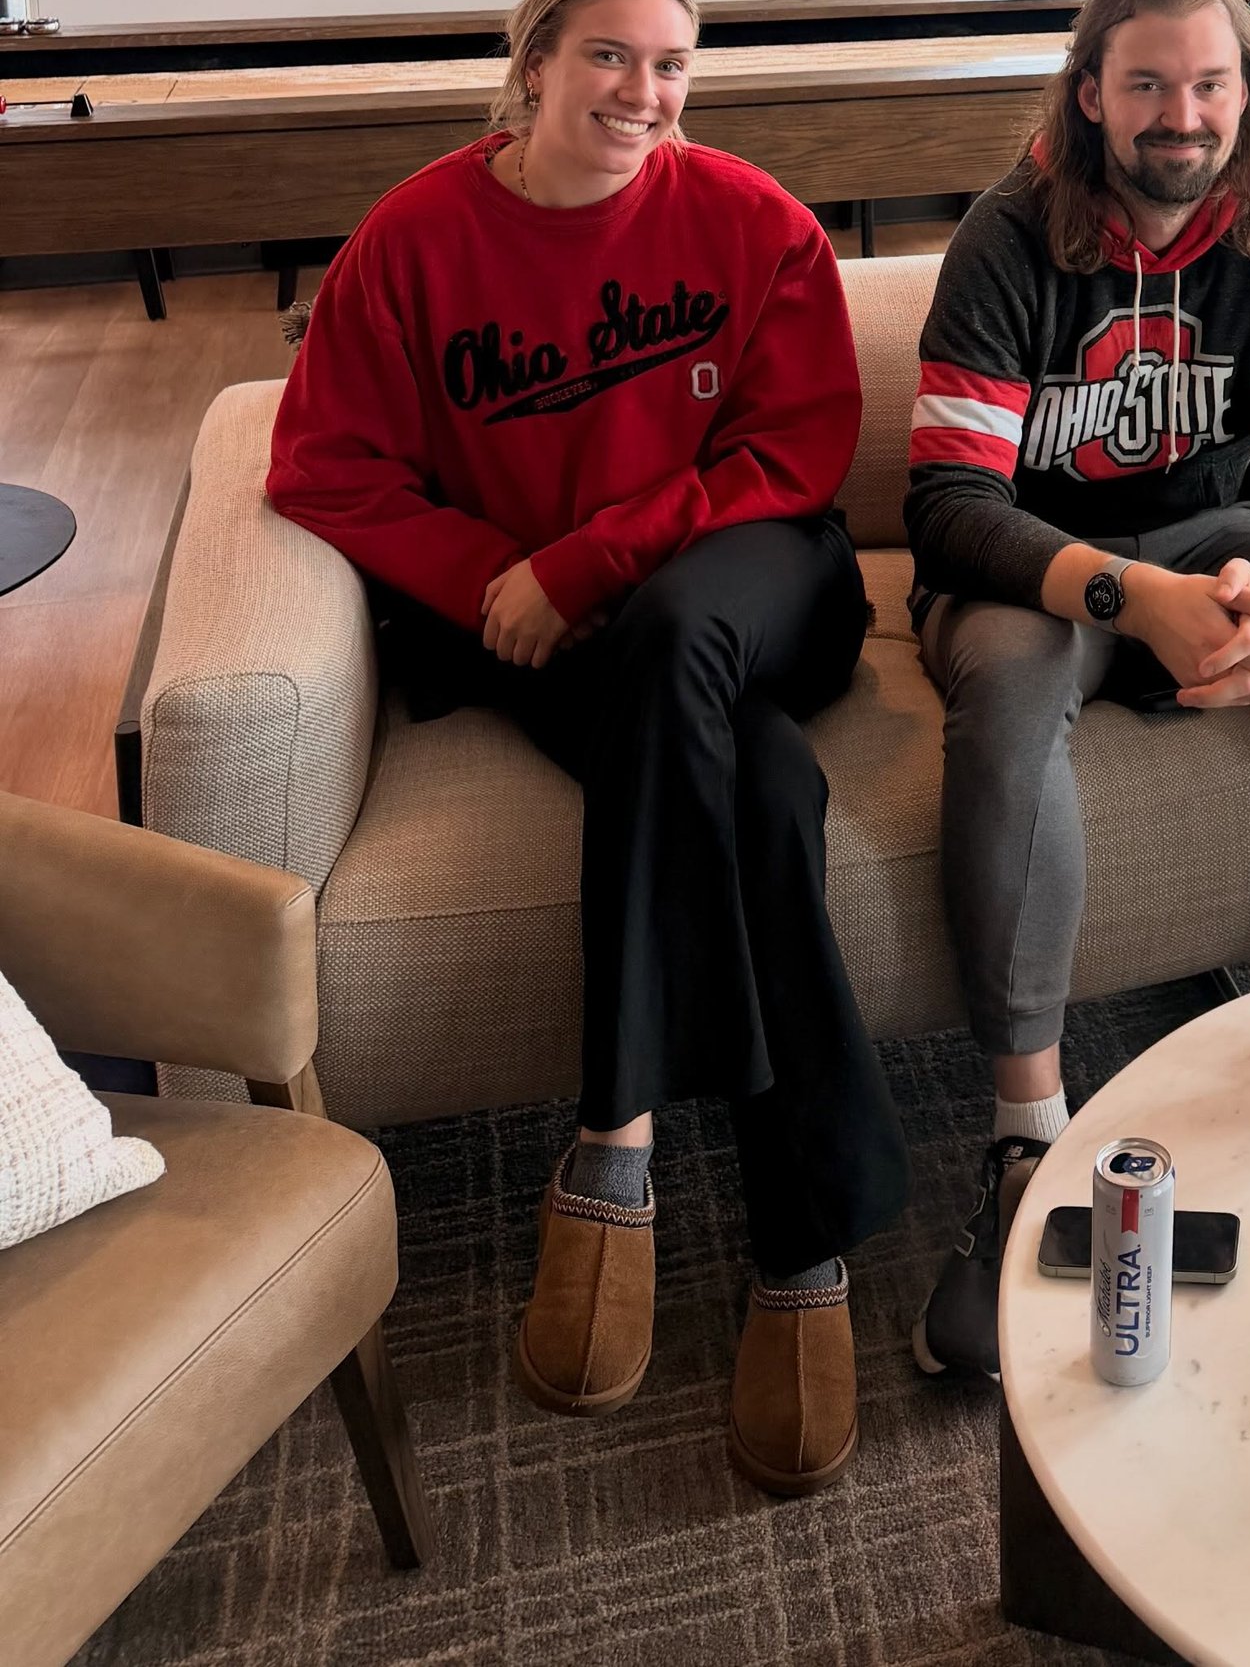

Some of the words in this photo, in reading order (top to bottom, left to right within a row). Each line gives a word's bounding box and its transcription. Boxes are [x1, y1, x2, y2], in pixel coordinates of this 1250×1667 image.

[444, 322, 568, 411] Ohio
[588, 279, 730, 367] State
[691, 360, 720, 401] O
[535, 379, 593, 411] BUCKEYES
[1024, 379, 1124, 472] OHIO
[1118, 362, 1235, 450] STATE
[1097, 1258, 1113, 1338] Michelob
